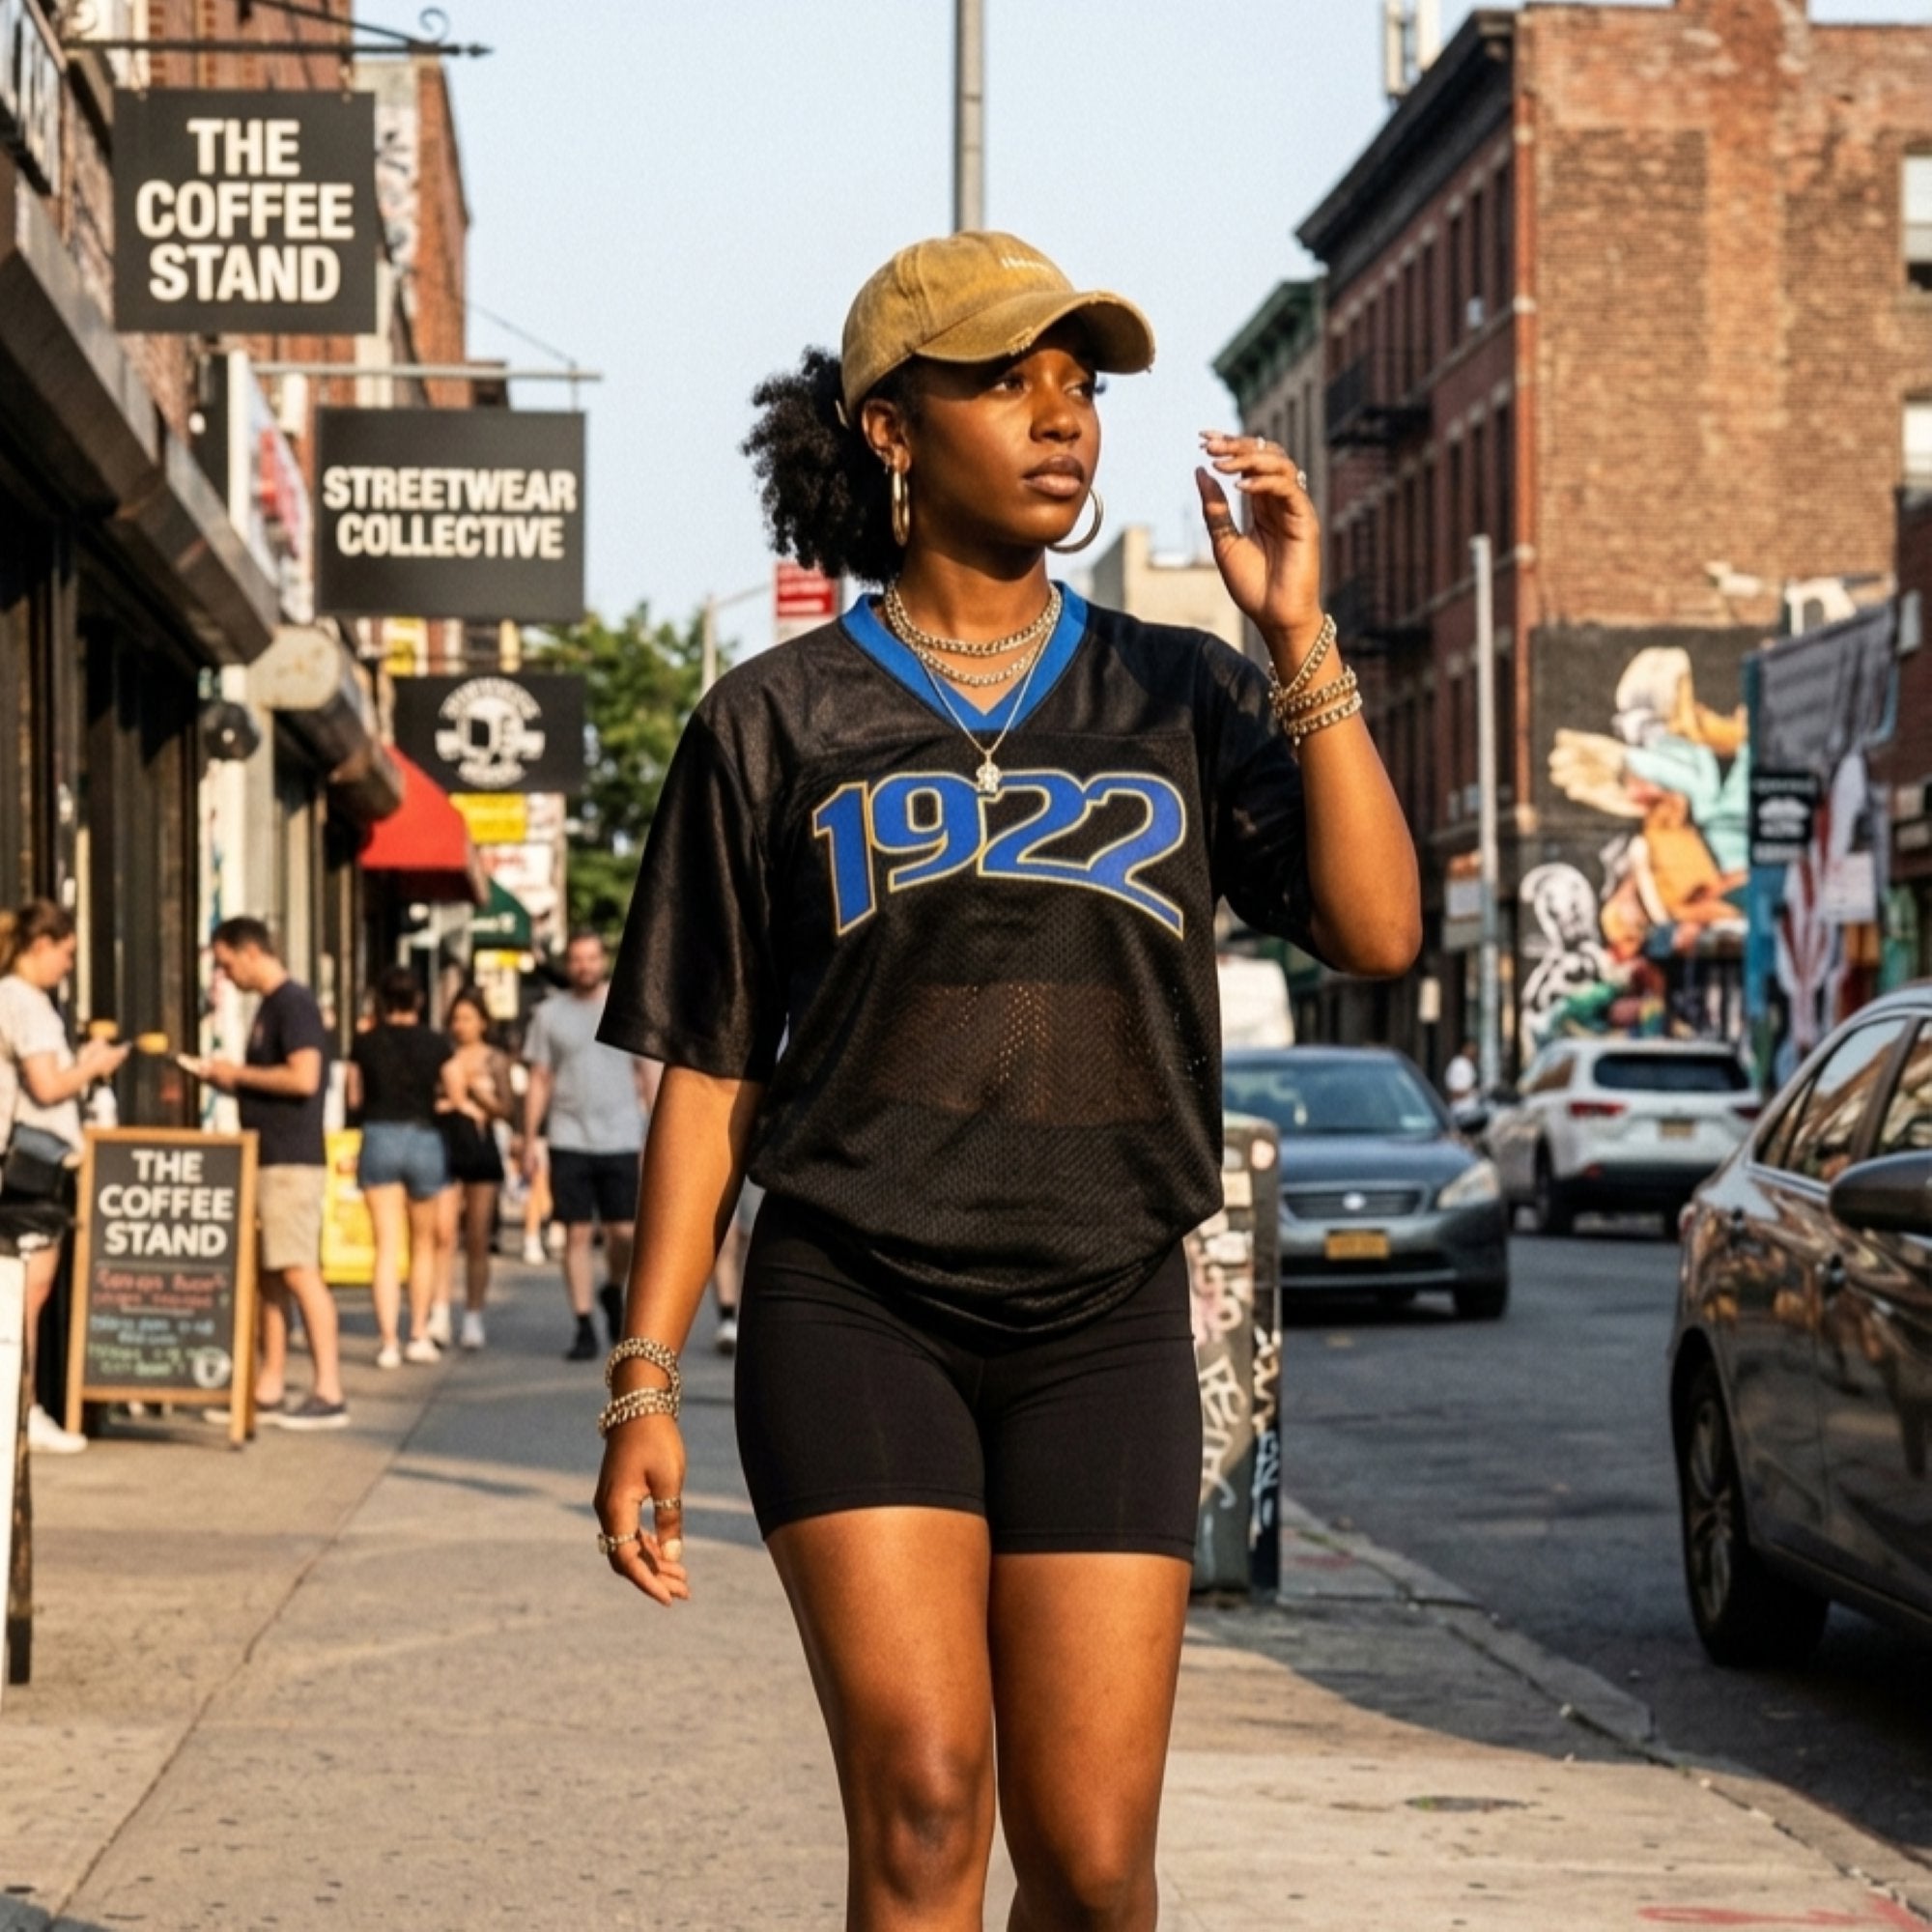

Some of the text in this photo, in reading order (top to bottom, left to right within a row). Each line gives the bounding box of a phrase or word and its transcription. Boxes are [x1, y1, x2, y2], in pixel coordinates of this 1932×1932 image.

[187, 119, 300, 177] THE
[136, 180, 355, 240] COFFEE
[149, 243, 340, 302] STAND
[323, 467, 577, 512] STREETWEAR
[336, 514, 564, 559] COLLECTIVE
[812, 769, 1186, 941] 1922
[131, 1150, 203, 1183] THE
[98, 1184, 234, 1221] COFFEE
[104, 1222, 228, 1257] STAND
